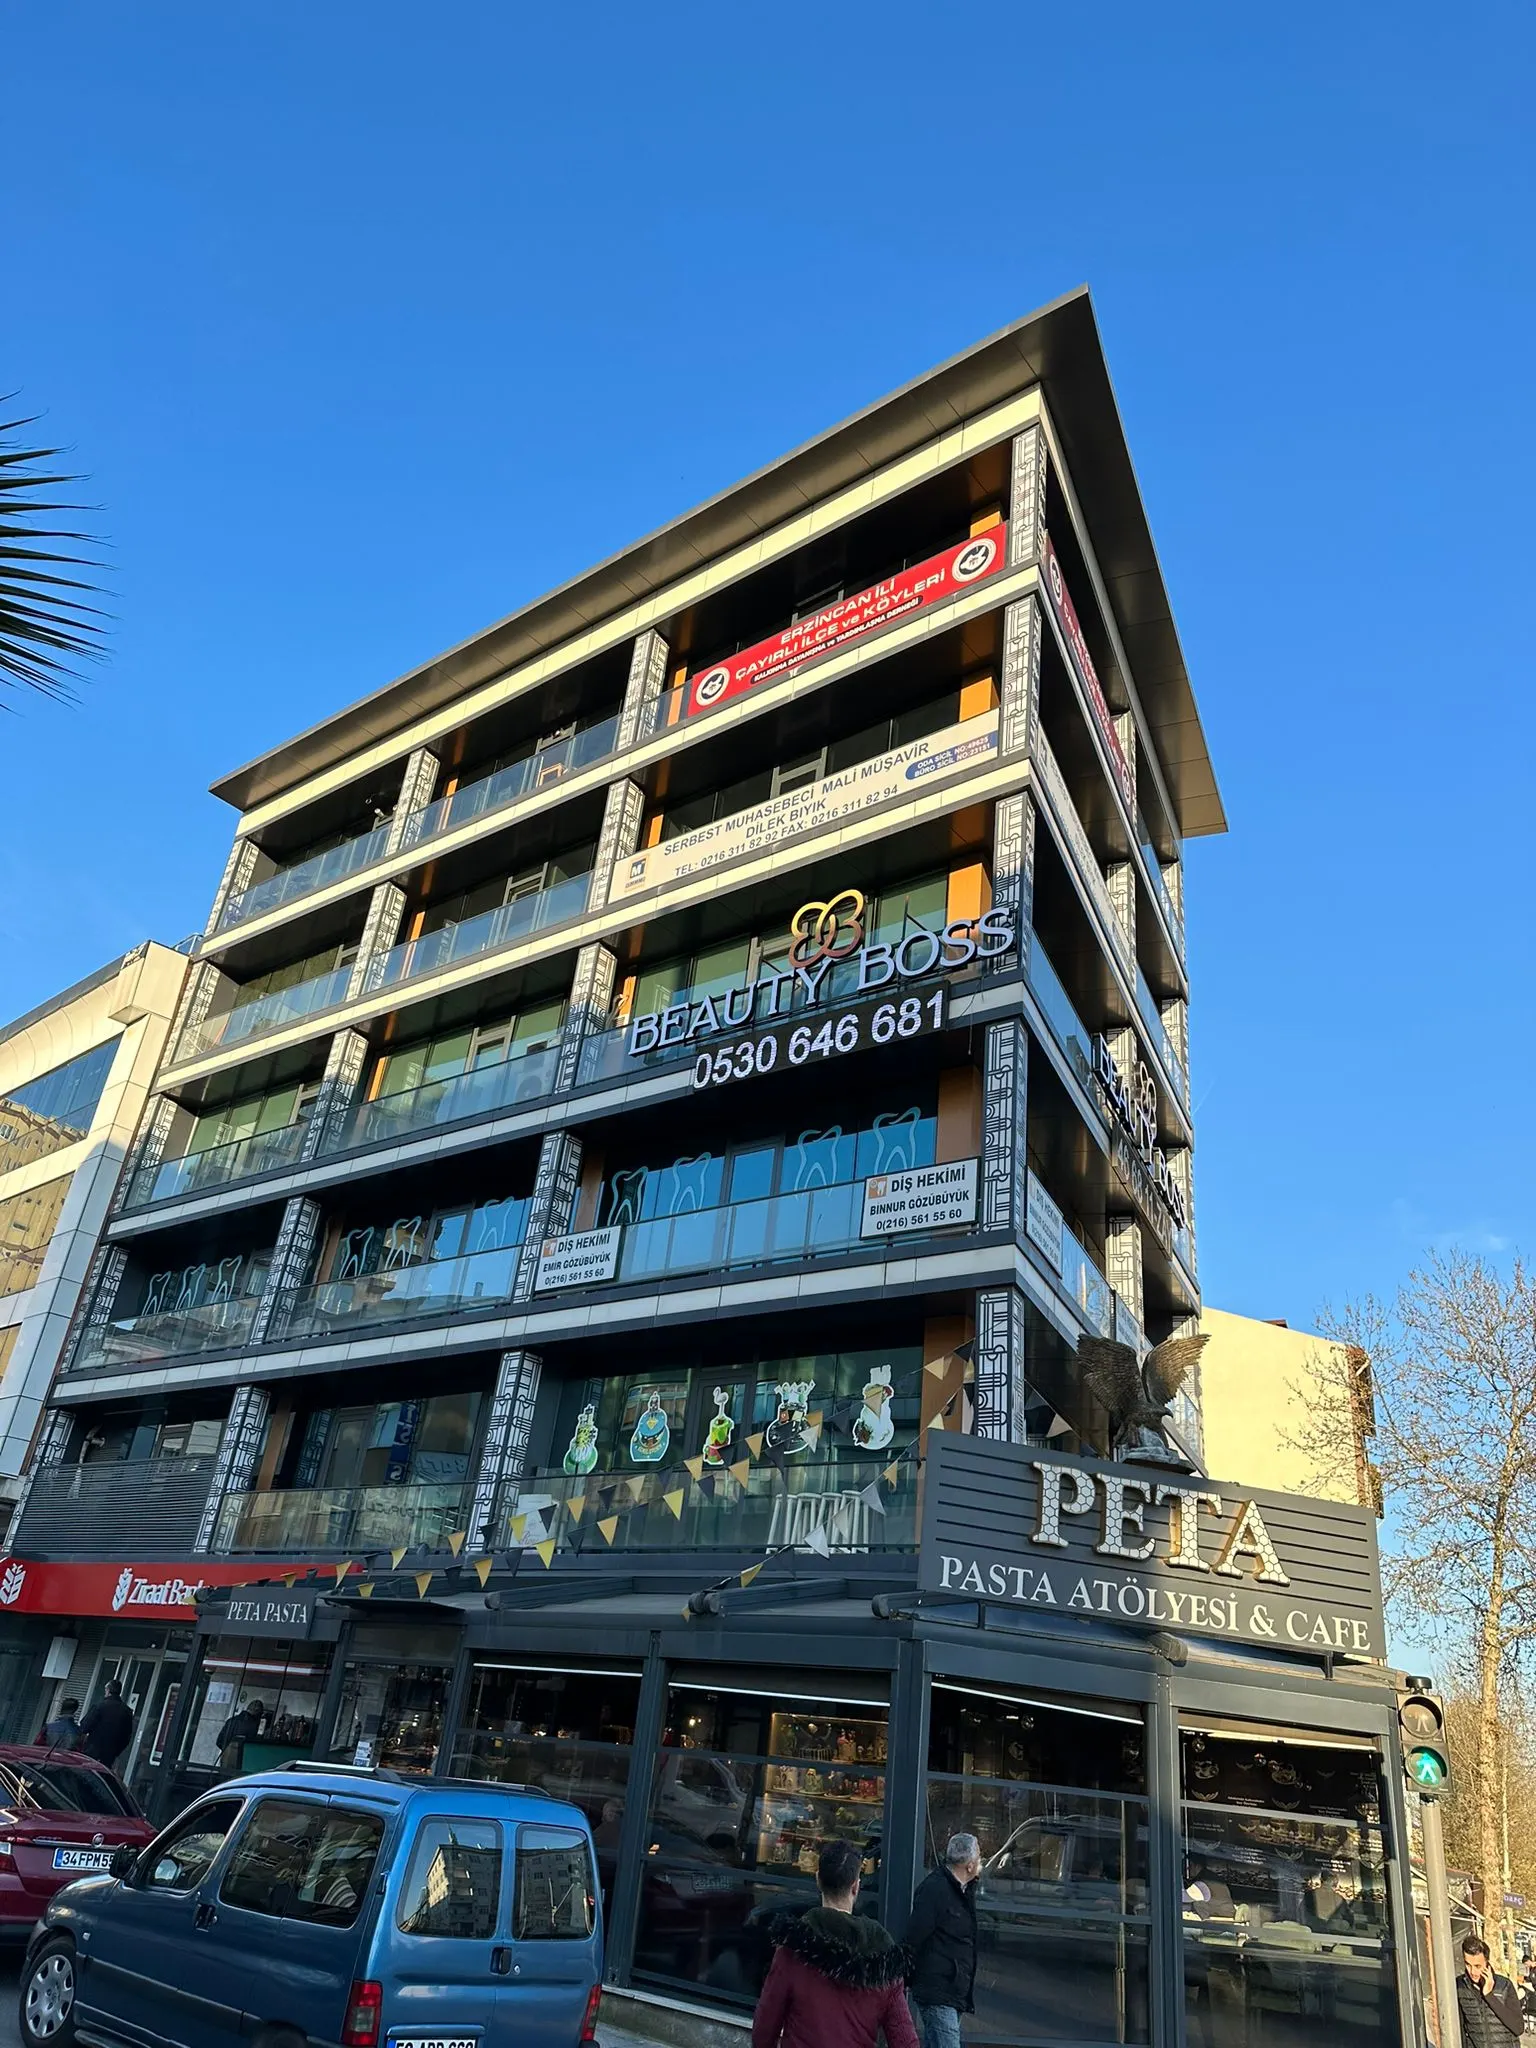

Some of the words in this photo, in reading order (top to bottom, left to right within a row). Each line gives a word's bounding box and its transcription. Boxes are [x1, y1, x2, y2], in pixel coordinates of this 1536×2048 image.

[735, 641, 798, 680] ÇAYIRLI
[801, 622, 839, 650] İLÇE
[842, 614, 860, 629] ve
[863, 568, 945, 619] KÖYLERİ
[781, 592, 872, 645] ERZİNCAN
[875, 578, 896, 599] İLİ
[664, 825, 723, 857] SERBEST
[725, 786, 815, 833] MUHASEBECİ
[821, 771, 857, 795] MALİ
[860, 742, 930, 780] MÜŞAVİR
[745, 812, 786, 840] DİLEK
[789, 797, 827, 823] BIYIK
[675, 861, 699, 877] TEL:
[700, 850, 726, 868] 0216
[728, 843, 747, 858] 311
[749, 836, 762, 850] 82
[765, 831, 778, 844] 92
[781, 820, 809, 838] FAX:
[811, 808, 839, 827] 0216
[842, 799, 861, 816] 311
[866, 791, 880, 806] 82
[884, 784, 899, 799] 94
[628, 958, 831, 1057] BEAUTY
[857, 907, 1015, 991] BOSS
[692, 1034, 778, 1090] 0530
[788, 1012, 859, 1066] 646
[870, 989, 944, 1044] 681
[891, 1176, 913, 1193] DİŞ
[917, 1164, 966, 1188] HEKİMİ
[908, 1189, 970, 1209] GÖZÜBÜYÜK
[876, 1217, 908, 1231] 0(216)
[911, 1213, 929, 1225] 561
[933, 1211, 946, 1221] 55
[949, 1208, 962, 1219] 60
[558, 1238, 574, 1254] DİŞ
[576, 1230, 611, 1250] HEKİMİ
[563, 1251, 611, 1269] GÖZÜBÜYÜK
[544, 1274, 567, 1286] 0(216)
[569, 1272, 582, 1281] 561
[584, 1269, 594, 1279] 55
[595, 1268, 605, 1277] 60
[1030, 1460, 1292, 1587] PETA
[227, 1601, 261, 1621] PETA
[264, 1602, 307, 1624] PASTA
[940, 1555, 1059, 1605] PASTA
[1068, 1576, 1239, 1632] ATÖLYESİ
[1249, 1604, 1278, 1638] &
[1286, 1609, 1372, 1652] CAFE
[63, 1851, 77, 1866] 34
